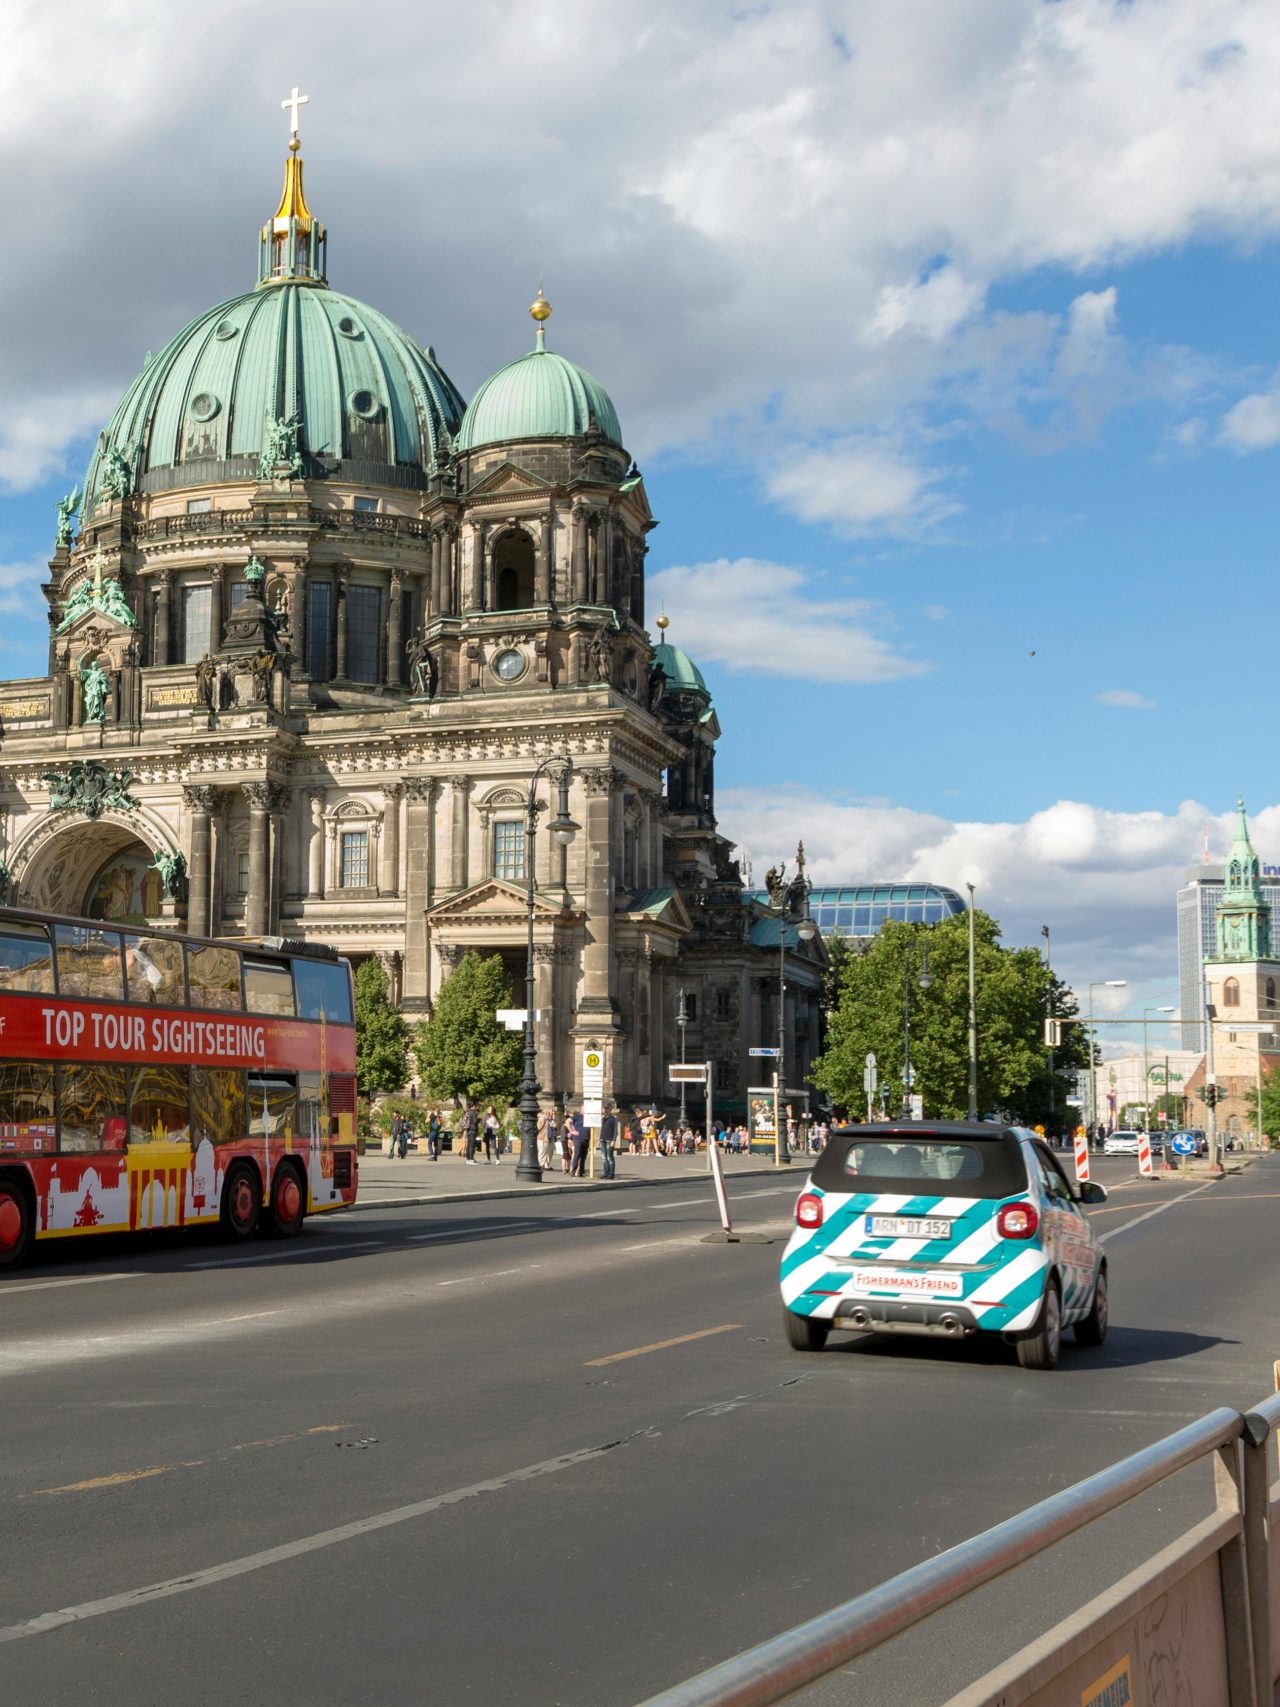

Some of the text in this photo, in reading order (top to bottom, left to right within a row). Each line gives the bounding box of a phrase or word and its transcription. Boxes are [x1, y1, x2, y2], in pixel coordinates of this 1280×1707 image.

[42, 1008, 265, 1058] TOP TOUR SIGHTSEEING
[874, 1219, 948, 1235] ARN DT 152
[921, 1277, 958, 1290] FRIEND
